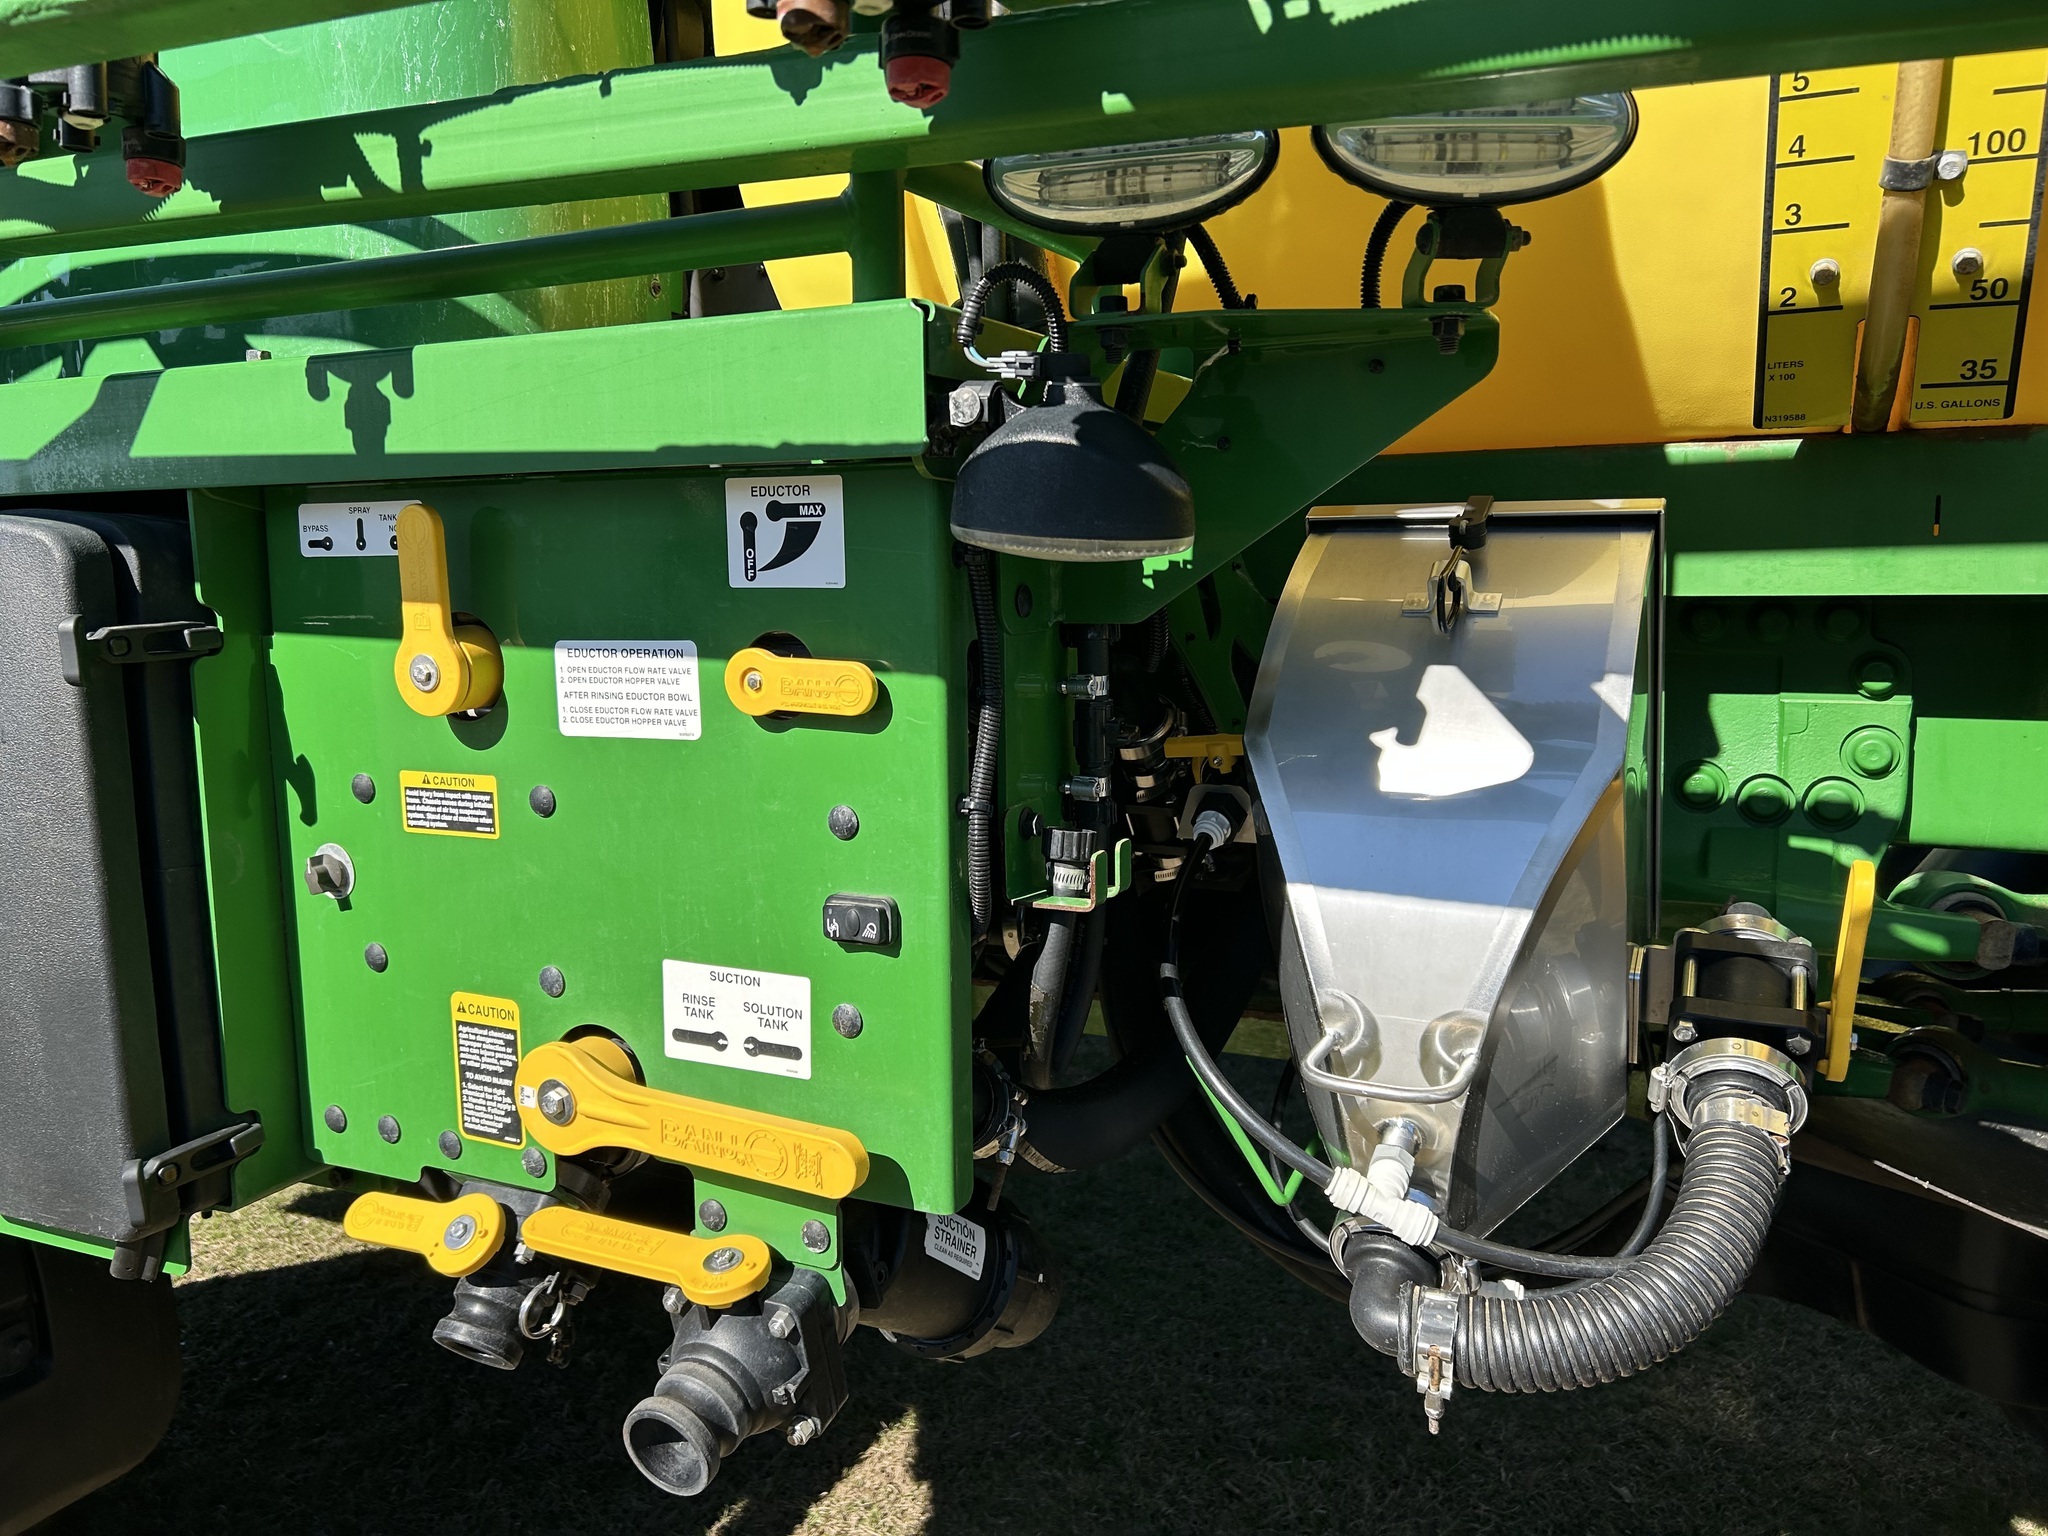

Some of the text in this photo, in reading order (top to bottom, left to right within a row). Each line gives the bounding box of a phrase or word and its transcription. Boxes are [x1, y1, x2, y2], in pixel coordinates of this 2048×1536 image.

[1792, 71, 1810, 93] 5
[1788, 134, 1806, 158] 4
[1967, 128, 2027, 156] 100
[1784, 203, 1802, 226] 3
[1969, 277, 2009, 301] 50
[1780, 287, 1797, 308] 2
[1767, 360, 1804, 370] LITERS
[1960, 358, 1998, 381] 35
[1778, 373, 1796, 381] 100
[1915, 398, 2001, 410] U.S. GALLONS
[1764, 413, 1806, 422] N319588
[750, 485, 811, 497] EDUCTOR
[799, 505, 823, 516] MAX
[746, 548, 755, 580] OFF
[567, 648, 684, 659] EDUCTOR OPERATION
[567, 666, 586, 674] OPEN
[591, 692, 624, 700] RINSING
[626, 692, 666, 701] EDUCTOR
[668, 693, 693, 702] BOWL
[569, 706, 593, 714] CLOSE
[654, 708, 673, 716] RATE
[570, 716, 594, 724] CLOSE
[664, 718, 687, 726] VALVE
[432, 776, 475, 787] CAUTION
[709, 970, 761, 987] SUCTION
[682, 993, 716, 1008] RINSE
[468, 1003, 515, 1021] CAUTION
[684, 1006, 714, 1020] TANK
[743, 1001, 803, 1020] SOLUTION
[757, 1017, 789, 1031] TANK
[474, 1074, 492, 1082] AVOID
[937, 1214, 975, 1242] SUCTION
[934, 1226, 977, 1260] STRAINER
[934, 1243, 947, 1254] CLEAN
[953, 1253, 973, 1268] REQUIRED
